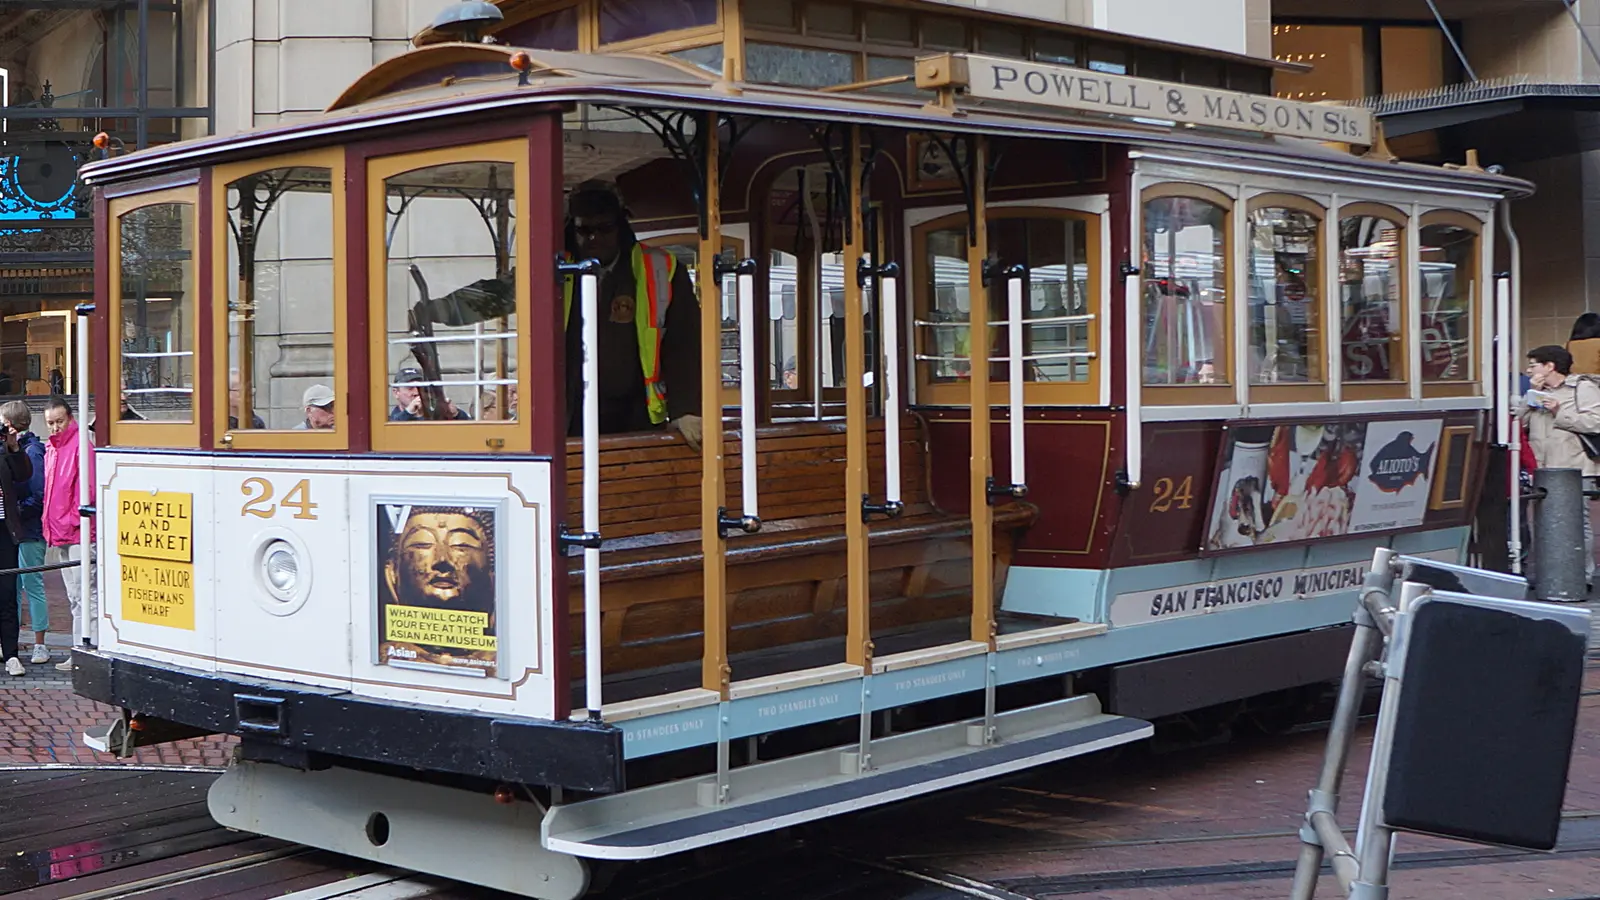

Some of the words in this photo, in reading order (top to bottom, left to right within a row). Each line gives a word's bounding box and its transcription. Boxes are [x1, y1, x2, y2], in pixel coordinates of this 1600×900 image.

[991, 65, 1151, 111] POWELL
[1165, 88, 1188, 116] &
[1203, 95, 1314, 132] MASON
[1323, 111, 1362, 138] Sts.
[1377, 456, 1421, 475] ALIOTO'S
[241, 477, 318, 520] 24
[1150, 475, 1193, 513] 24
[122, 500, 188, 519] POWELL
[138, 519, 171, 532] AND
[120, 531, 188, 551] MARKET
[122, 564, 139, 582] BAY
[154, 567, 190, 589] TAYLOR
[128, 587, 185, 606] FISHERMANS
[1150, 590, 1188, 616] SAN
[141, 603, 171, 618] WHARF
[389, 608, 419, 619] WHAT
[421, 611, 447, 621] WILL
[448, 613, 485, 625] CATCH
[390, 619, 418, 629] YOUR
[419, 622, 440, 632] EYE
[442, 625, 455, 633] AT
[457, 625, 480, 636] THE
[390, 629, 421, 641] ASIAN
[423, 633, 443, 643] ART
[446, 635, 496, 648] MUSEUM
[387, 645, 417, 658] Asian
[758, 705, 777, 717] TWO
[779, 697, 817, 715] STANDEES
[819, 694, 839, 708] ONLY
[637, 725, 680, 740] STANDEES
[682, 719, 704, 733] ONLY
